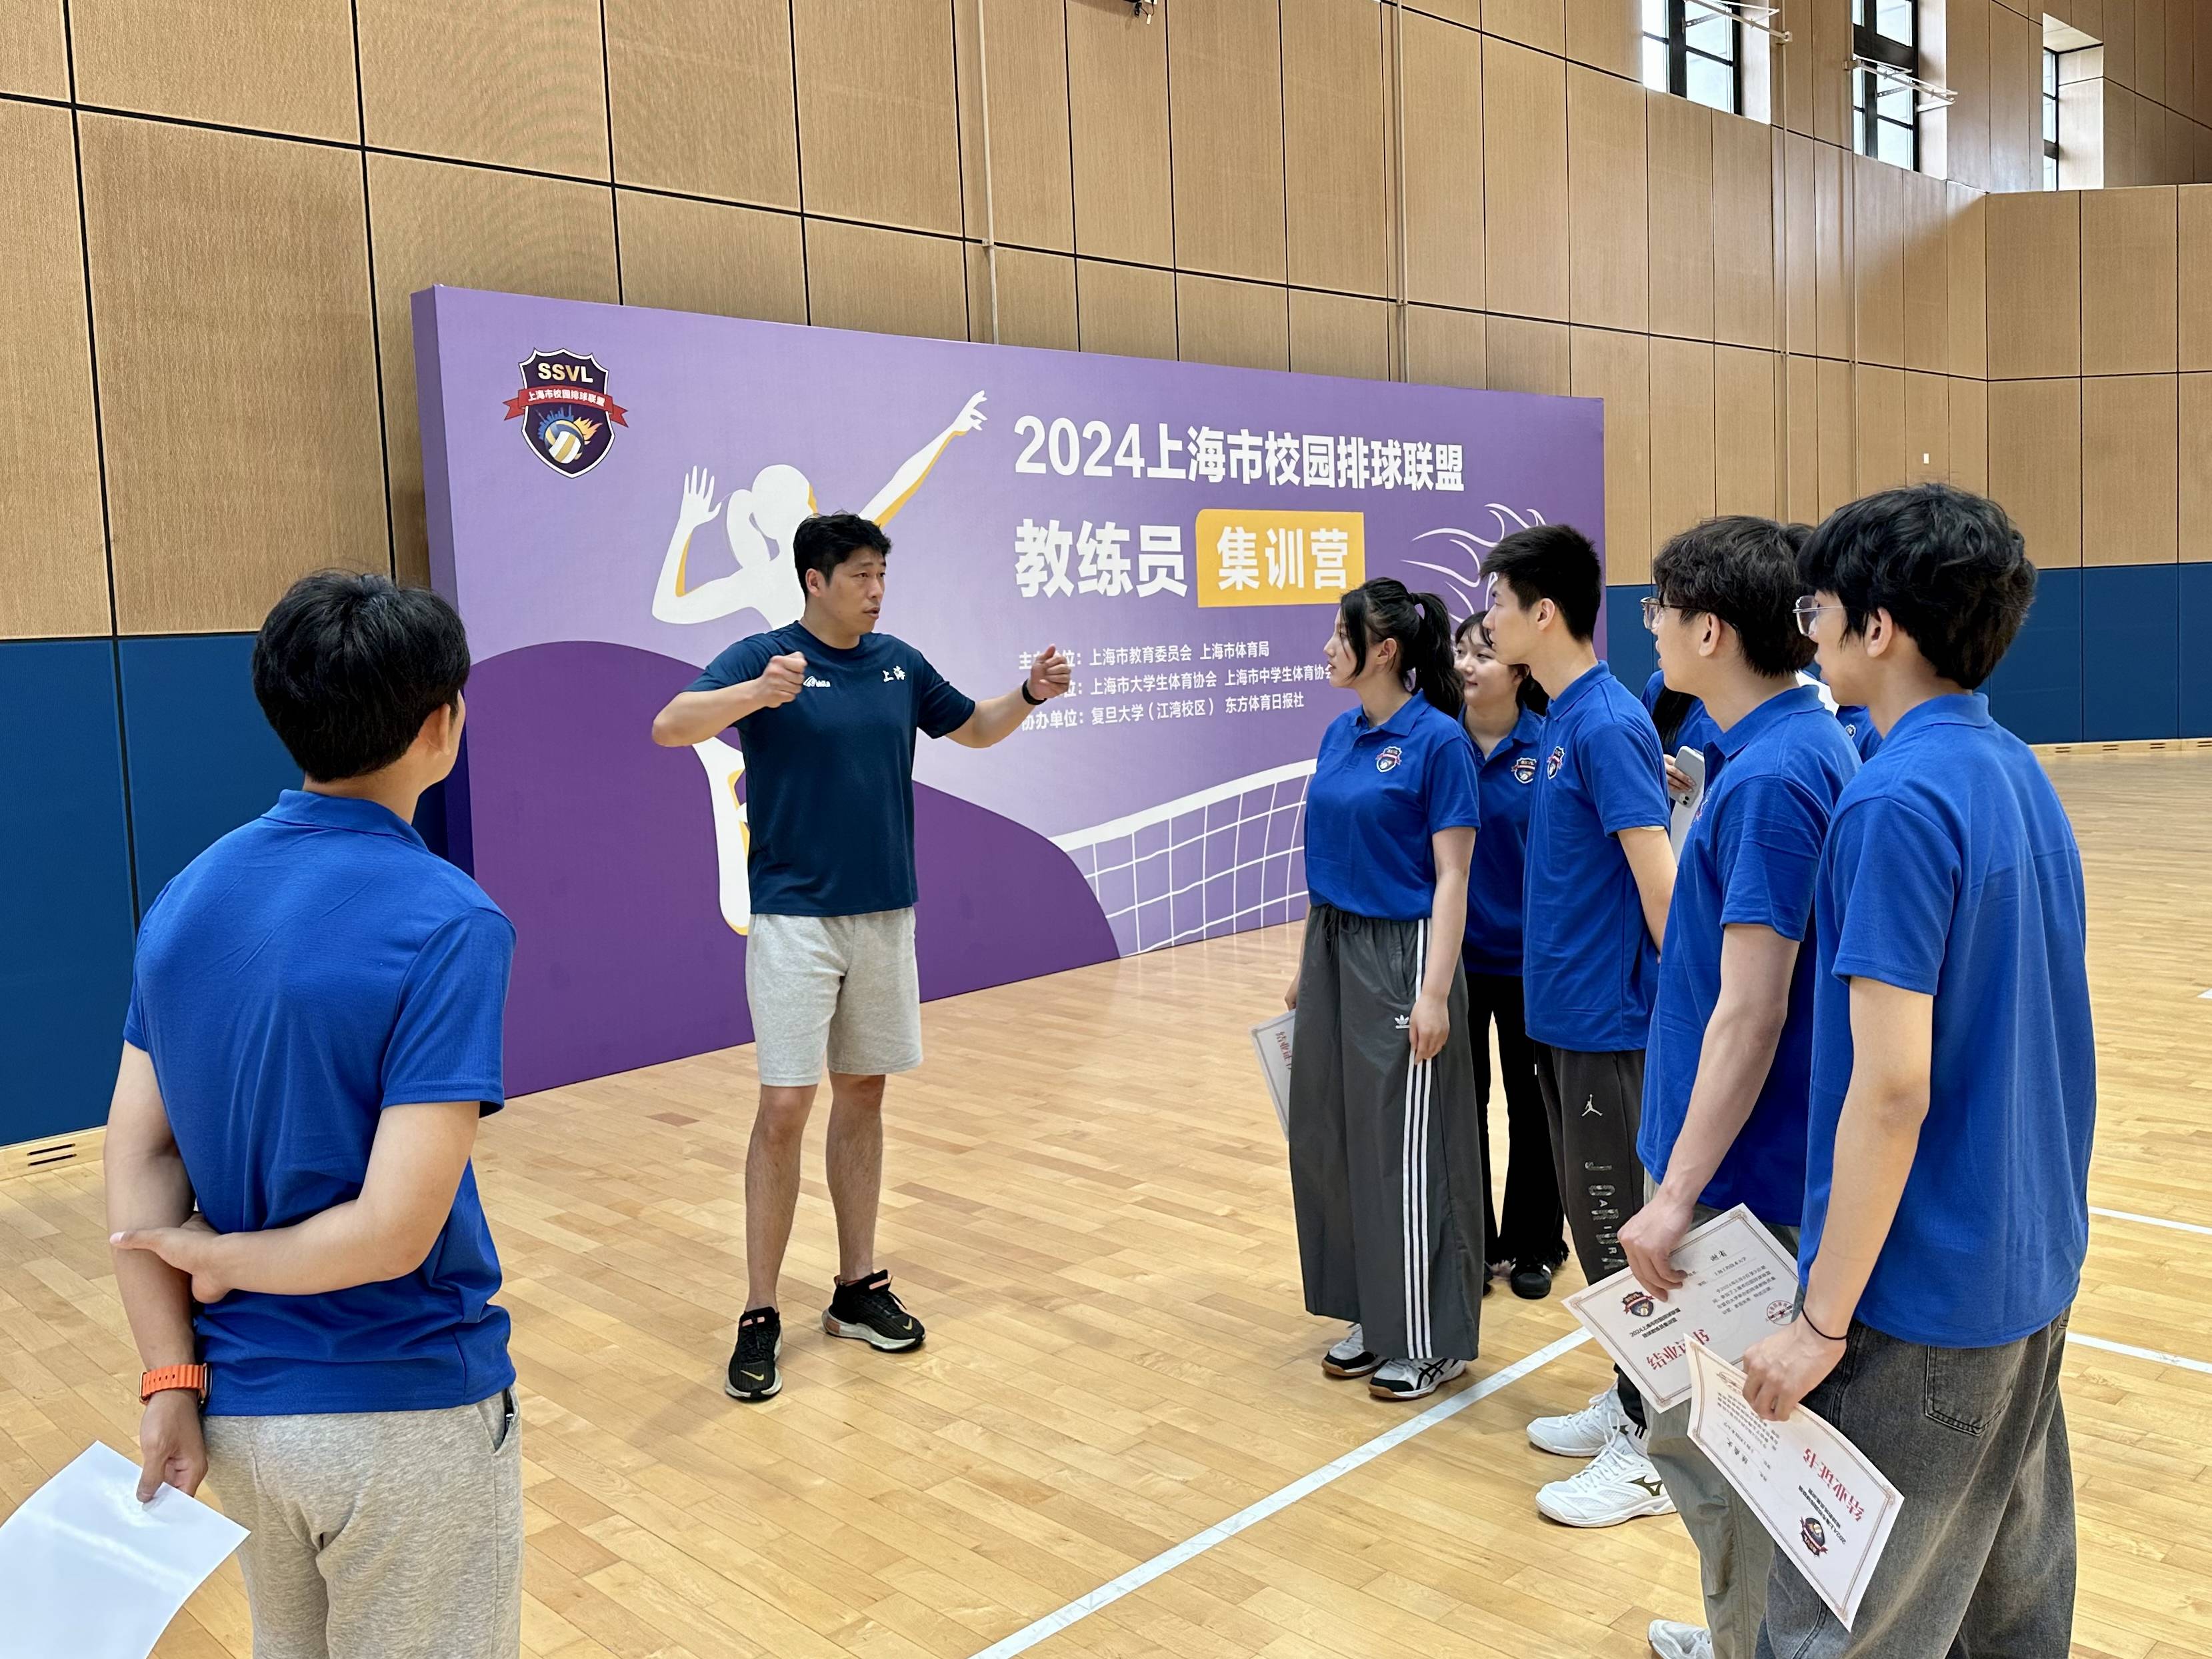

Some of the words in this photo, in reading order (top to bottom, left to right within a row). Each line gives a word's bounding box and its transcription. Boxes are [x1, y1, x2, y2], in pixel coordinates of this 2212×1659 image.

[538, 362, 593, 383] SSVL
[528, 389, 605, 407] 上海市校园排球联盟
[1014, 415, 1464, 491] 2024上海市校园排球联盟
[1015, 518, 1187, 598] 教练员
[1217, 526, 1348, 591] 集训营
[1089, 644, 1192, 665] 上海市教育委员会
[1200, 641, 1269, 660] 上海市体育局
[882, 665, 906, 683] 上海
[1091, 671, 1217, 695] 上海市大学生体育协会
[1225, 691, 1305, 713] 东方体育日报社
[1803, 1448, 1864, 1522] 结业证书
